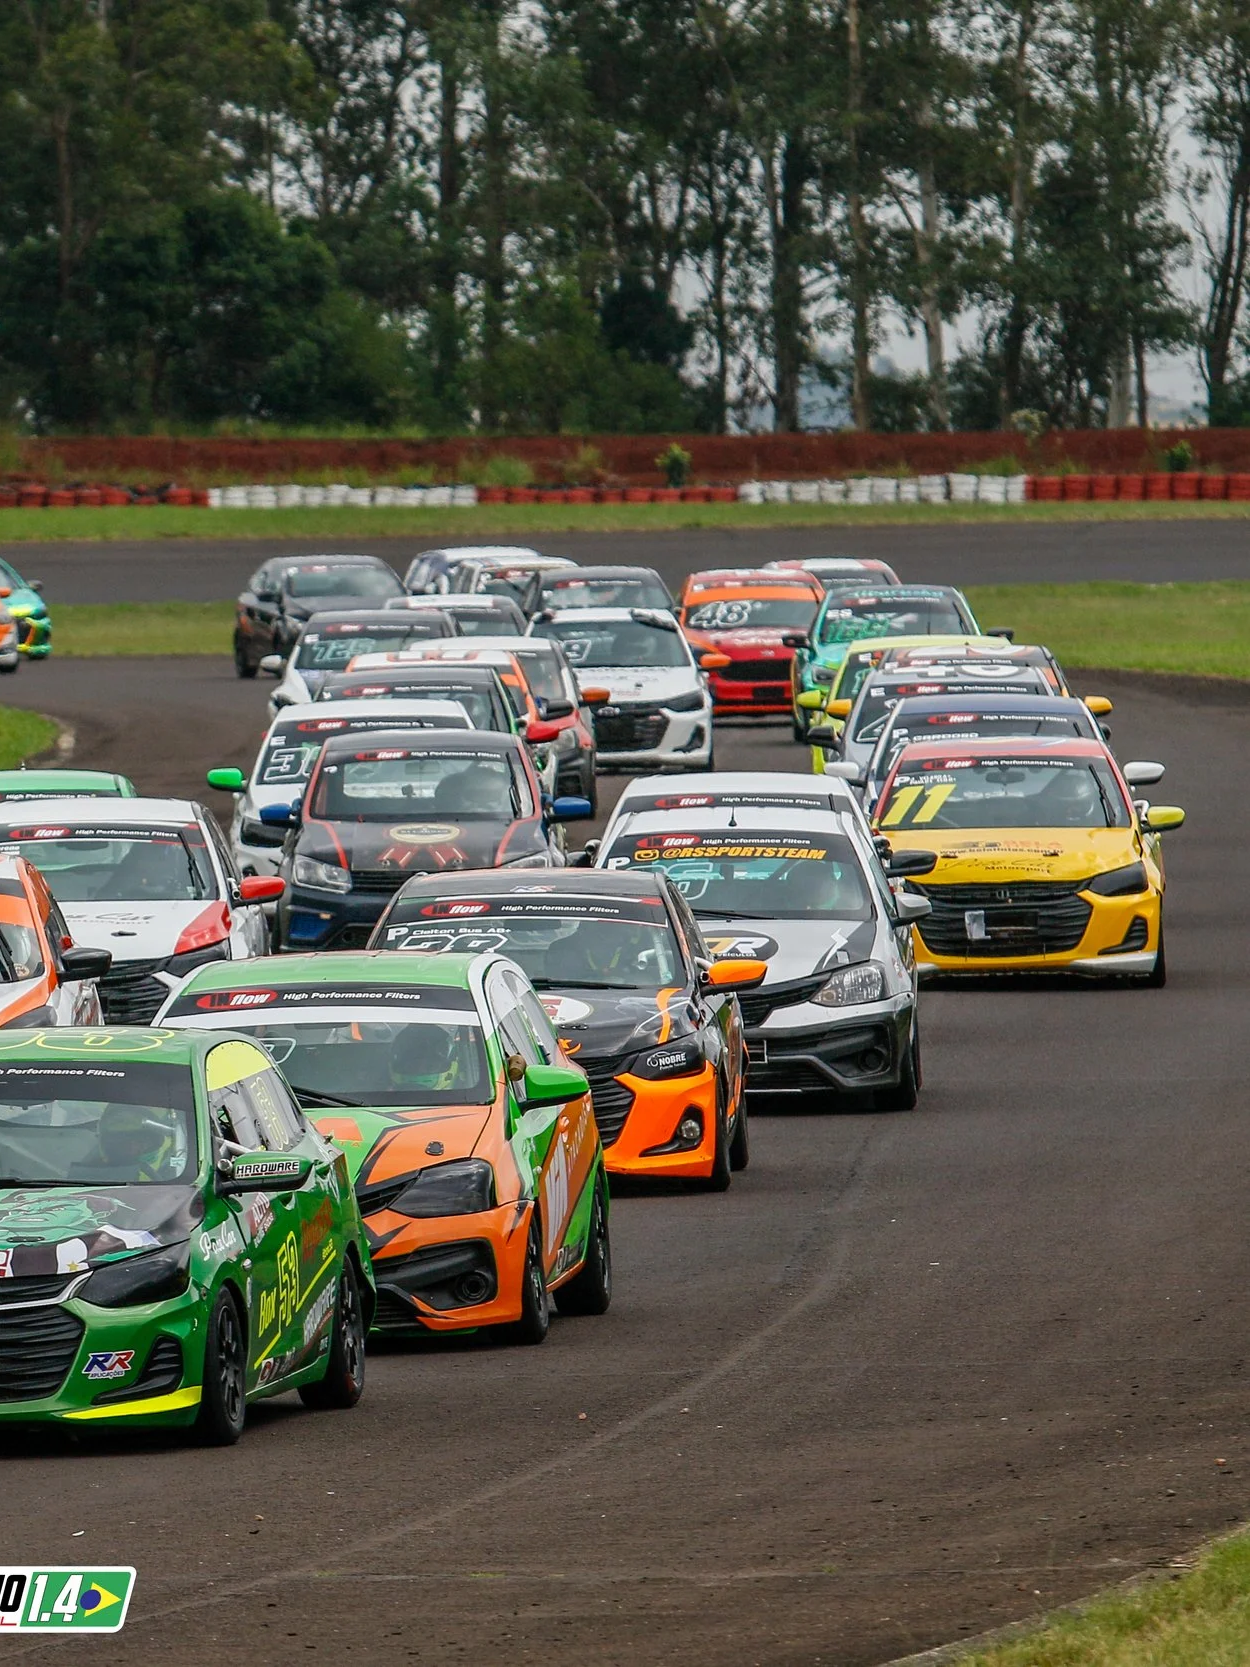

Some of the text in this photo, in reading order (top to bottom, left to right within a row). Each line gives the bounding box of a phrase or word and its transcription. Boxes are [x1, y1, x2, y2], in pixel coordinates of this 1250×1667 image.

[880, 784, 957, 826] 11
[96, 829, 150, 837] Performance
[151, 830, 178, 838] Filters
[662, 847, 827, 860] @RSSPORTSTEAM
[607, 856, 631, 870] P
[525, 905, 587, 913] Performance
[588, 906, 620, 914] Filters
[386, 927, 410, 941] P
[283, 991, 421, 1001] High Performance Filters
[658, 1053, 687, 1067] NOBRE
[6, 1067, 85, 1076] Performance
[86, 1068, 126, 1078] Filters
[236, 1161, 299, 1175] HARDWARE
[84, 1351, 135, 1373] RR
